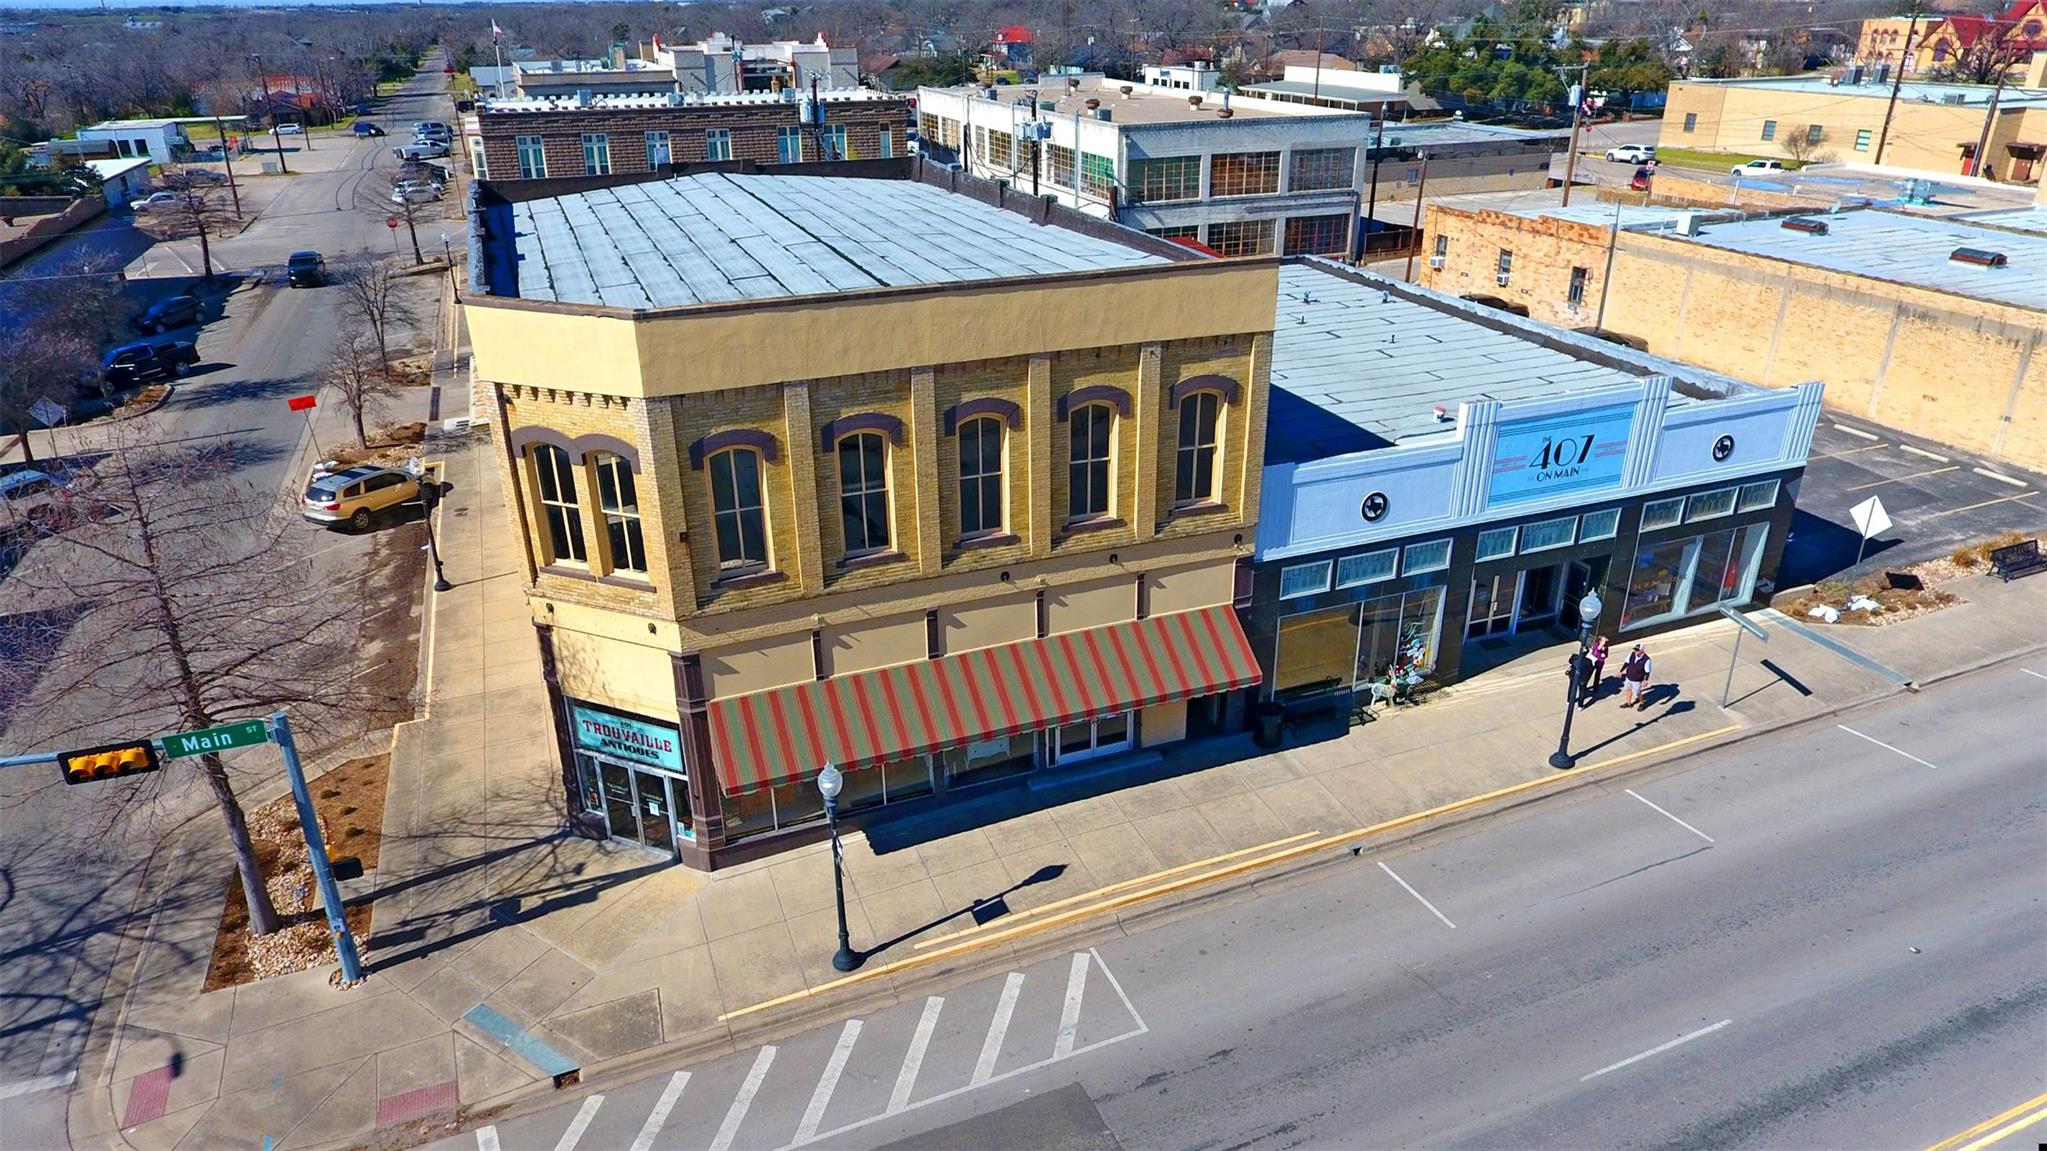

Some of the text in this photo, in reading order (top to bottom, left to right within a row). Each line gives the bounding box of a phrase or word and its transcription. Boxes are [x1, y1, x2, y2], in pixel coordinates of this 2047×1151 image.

[1529, 434, 1595, 470] 407
[1537, 467, 1580, 482] ON MAIN
[181, 725, 257, 752] Main ST
[583, 720, 672, 753] TROUVAILLE
[600, 738, 659, 759] ANTIQUES
